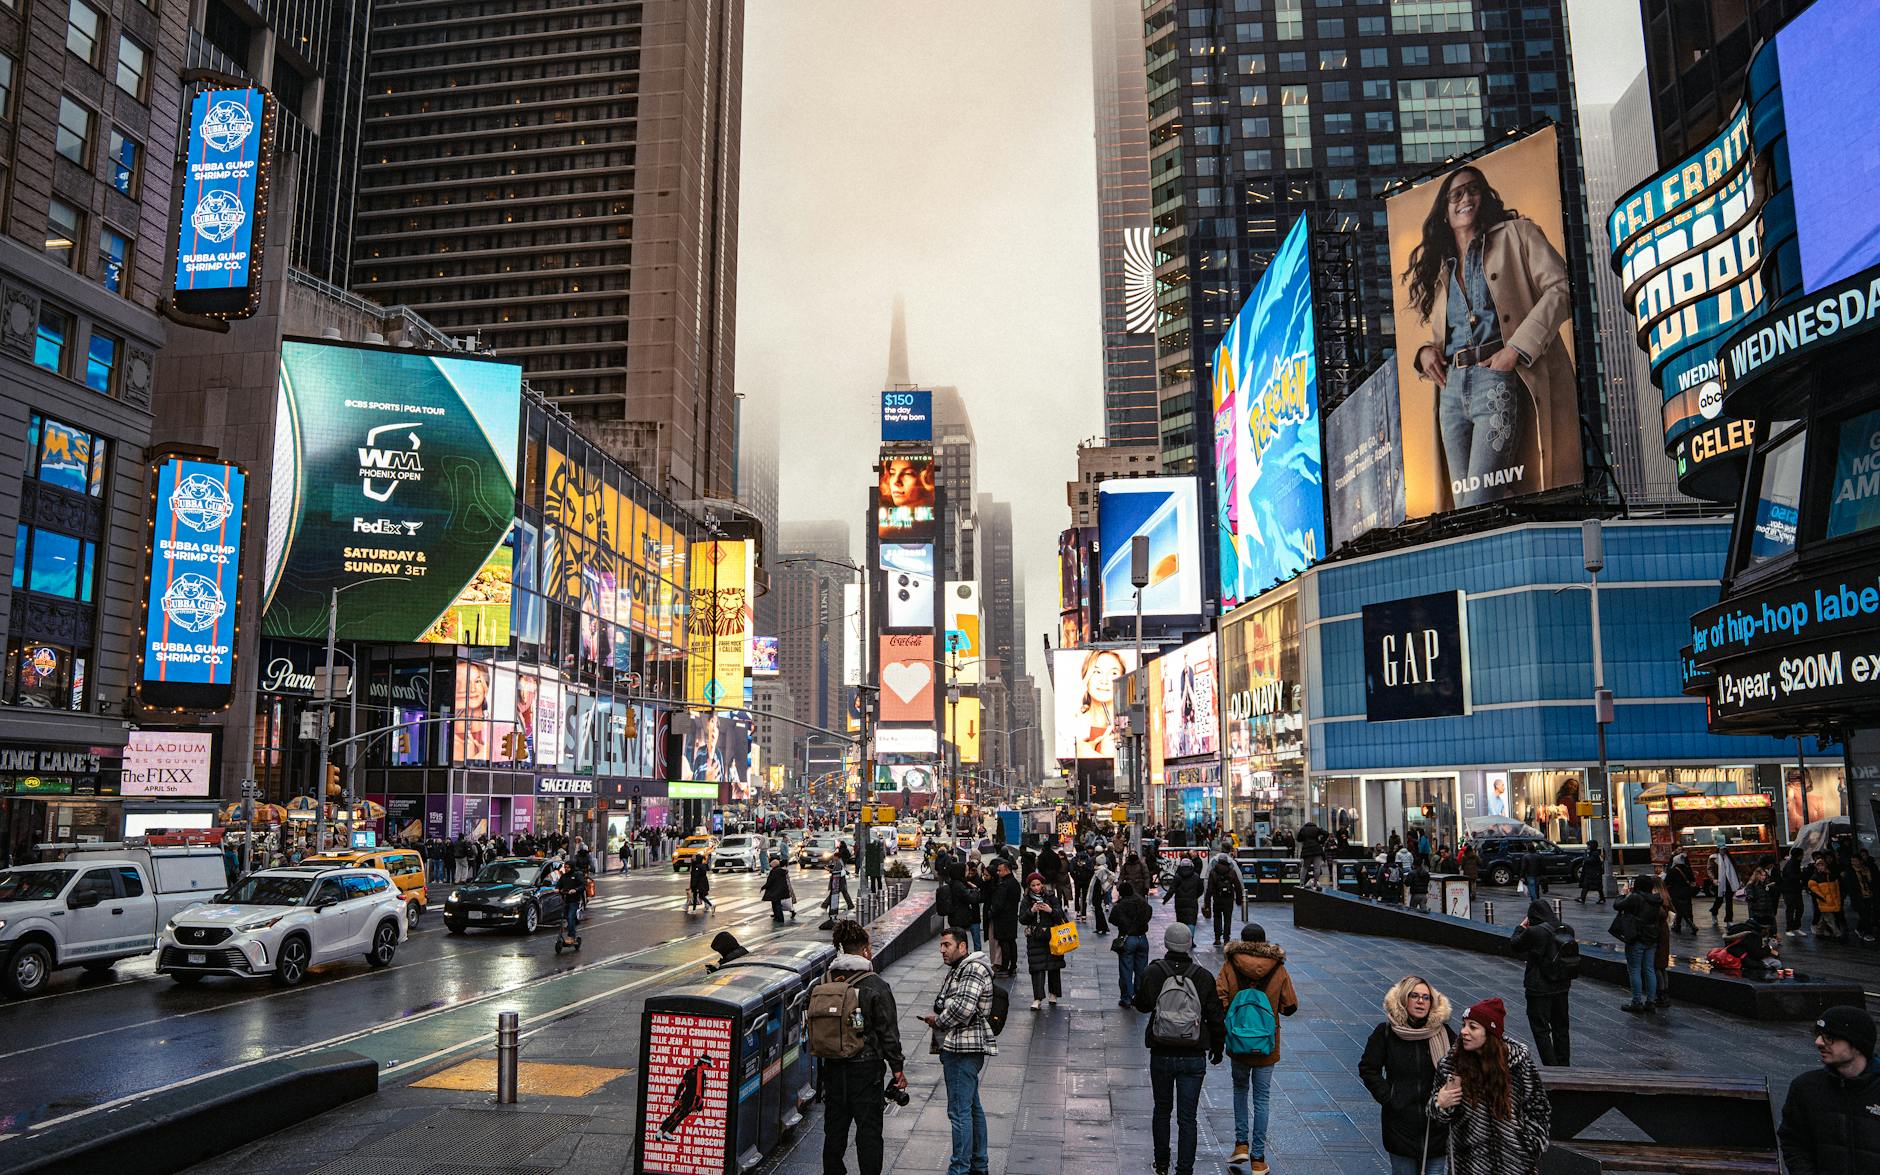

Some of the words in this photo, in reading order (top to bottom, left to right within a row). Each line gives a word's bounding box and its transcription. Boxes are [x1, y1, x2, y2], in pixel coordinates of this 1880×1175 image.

[192, 162, 224, 172] BUBBA
[226, 160, 254, 170] GUMP
[194, 170, 231, 181] SHRIMP
[232, 170, 250, 178] CO.
[183, 254, 216, 264] BUBBA
[217, 252, 246, 262] GUMP
[186, 262, 222, 272] SHRIMP
[224, 260, 241, 270] CO.
[884, 394, 914, 406] $150
[352, 400, 368, 408] CBS
[368, 401, 400, 412] SPORTS
[404, 404, 422, 414] PGA
[422, 406, 446, 416] TOUR
[884, 406, 896, 414] the
[897, 406, 911, 416] day
[884, 414, 908, 422] they're
[360, 468, 396, 480] PHOENIX
[398, 472, 420, 480] OPEN
[1452, 476, 1480, 494] OLD
[1483, 464, 1524, 488] NAVY
[353, 517, 402, 535] FedEx
[1352, 522, 1362, 537] OLD
[160, 540, 200, 552] BUBBA
[202, 543, 236, 554] GUMP
[344, 546, 415, 561] SATURDAY
[416, 552, 426, 562] &
[164, 550, 208, 562] SHRIMP
[210, 553, 230, 564] CO.
[344, 561, 400, 574] SUNDAY
[404, 564, 427, 576] 3ET
[1710, 616, 1724, 648] of
[1727, 602, 1809, 646] hip-hop
[152, 642, 193, 653] BUBBA
[194, 644, 228, 655] GUMP
[156, 652, 201, 664] SHRIMP
[202, 654, 223, 664] CO.
[1382, 629, 1439, 687] GAP
[1779, 650, 1844, 697] $20M
[1231, 690, 1251, 720] OLD
[1253, 680, 1284, 717] NAVY
[40, 751, 100, 772] CANE'S
[122, 770, 145, 783] the
[146, 768, 193, 783] FIXX
[540, 778, 592, 793] SKECHERS
[652, 1015, 669, 1024] JAM
[675, 1017, 694, 1026] BAD
[698, 1019, 732, 1029] MONEY
[651, 1025, 688, 1035] SMOOTH
[689, 1028, 730, 1039] CRIMINAL
[650, 1035, 667, 1044] BILLIE
[668, 1037, 683, 1045] JEAN
[692, 1039, 706, 1047] WANT
[707, 1040, 716, 1048] YOU
[717, 1041, 730, 1049] BACK
[650, 1045, 671, 1054] BLAME
[672, 1047, 679, 1055] IT
[681, 1048, 690, 1056] ON
[707, 1050, 730, 1059] BOOGIE
[649, 1055, 668, 1063] CAN
[672, 1056, 690, 1065] YOU
[720, 1061, 729, 1069] IT
[649, 1065, 663, 1074] THEY
[665, 1066, 682, 1075] DON'T
[721, 1071, 728, 1079] US
[648, 1084, 665, 1092] MAN
[668, 1086, 677, 1094] IN
[647, 1104, 659, 1112] KEEP
[694, 1118, 726, 1127] ABC
[686, 1126, 725, 1137] NATURE
[684, 1136, 691, 1144] IN
[694, 1137, 725, 1147] MOSCOW
[644, 1152, 675, 1161] THRILLER
[680, 1156, 692, 1164] I'LL
[693, 1157, 701, 1165] BE
[702, 1157, 724, 1167] THERE
[663, 1163, 670, 1171] BE
